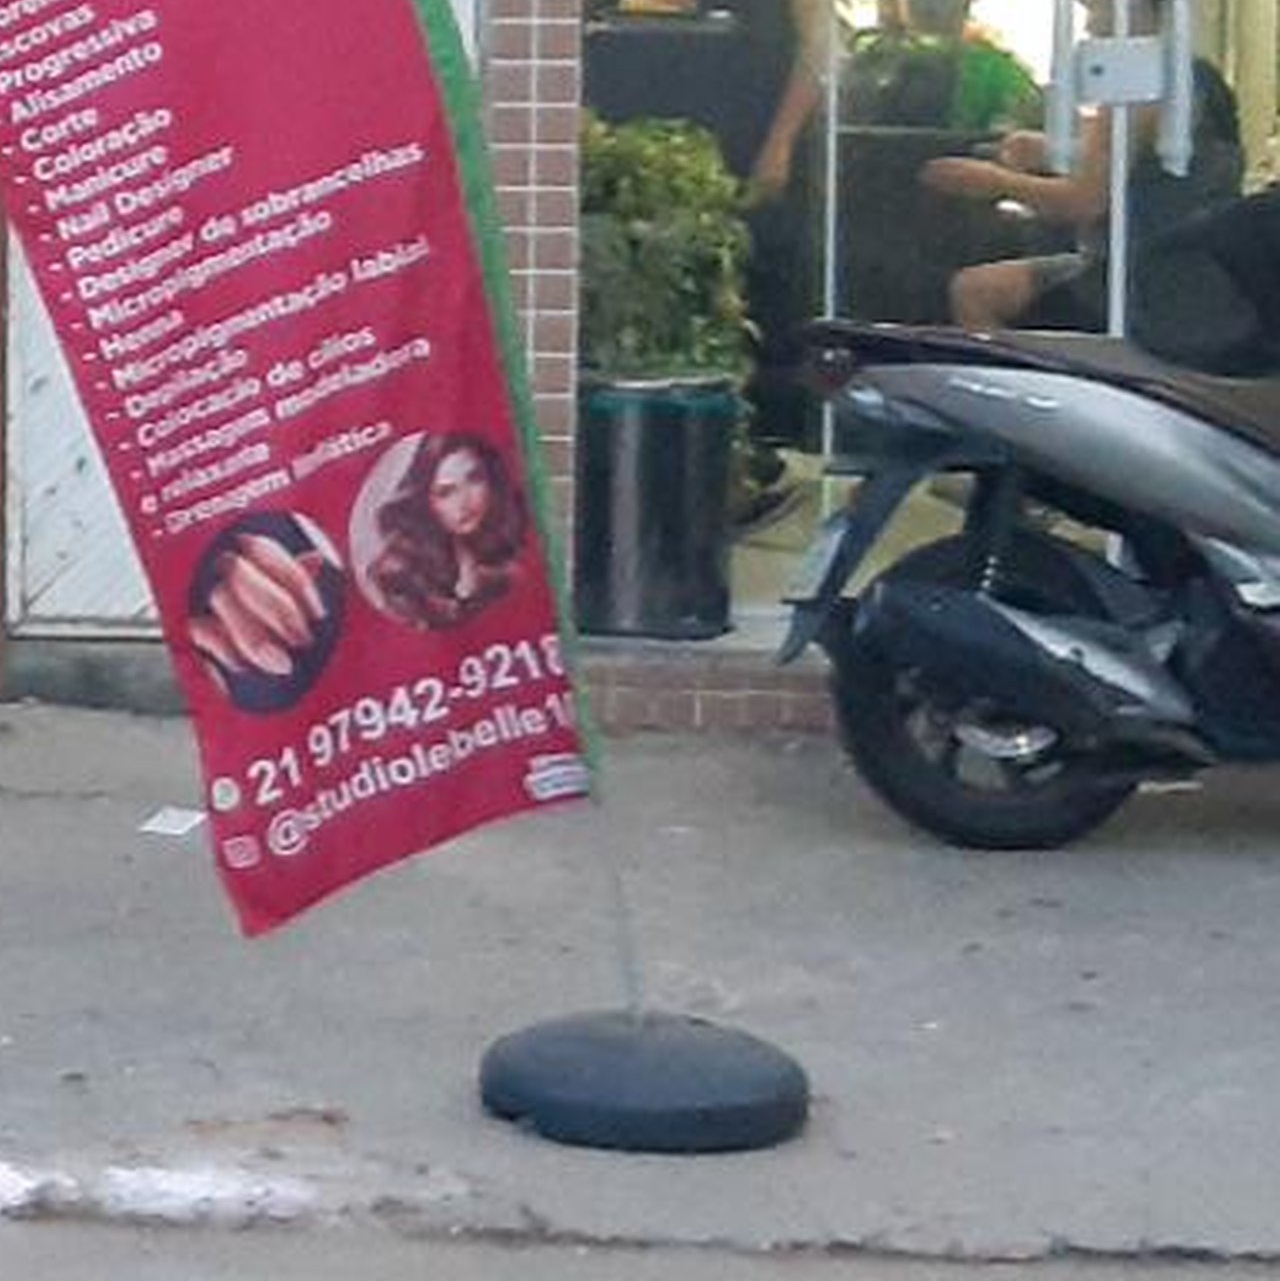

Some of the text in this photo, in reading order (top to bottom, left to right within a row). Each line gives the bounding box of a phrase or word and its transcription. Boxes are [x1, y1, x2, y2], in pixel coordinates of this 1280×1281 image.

[10, 42, 164, 123] Alisamento
[21, 108, 99, 151] Corte
[33, 108, 172, 182] Coloração
[45, 146, 168, 212] Manicure
[57, 146, 235, 241] Nail Designer
[199, 215, 237, 243] de
[241, 141, 425, 227] sobrancelhas
[66, 206, 185, 270] Pedicure
[350, 235, 430, 282] labial
[266, 358, 305, 388] de
[248, 747, 303, 807] 21
